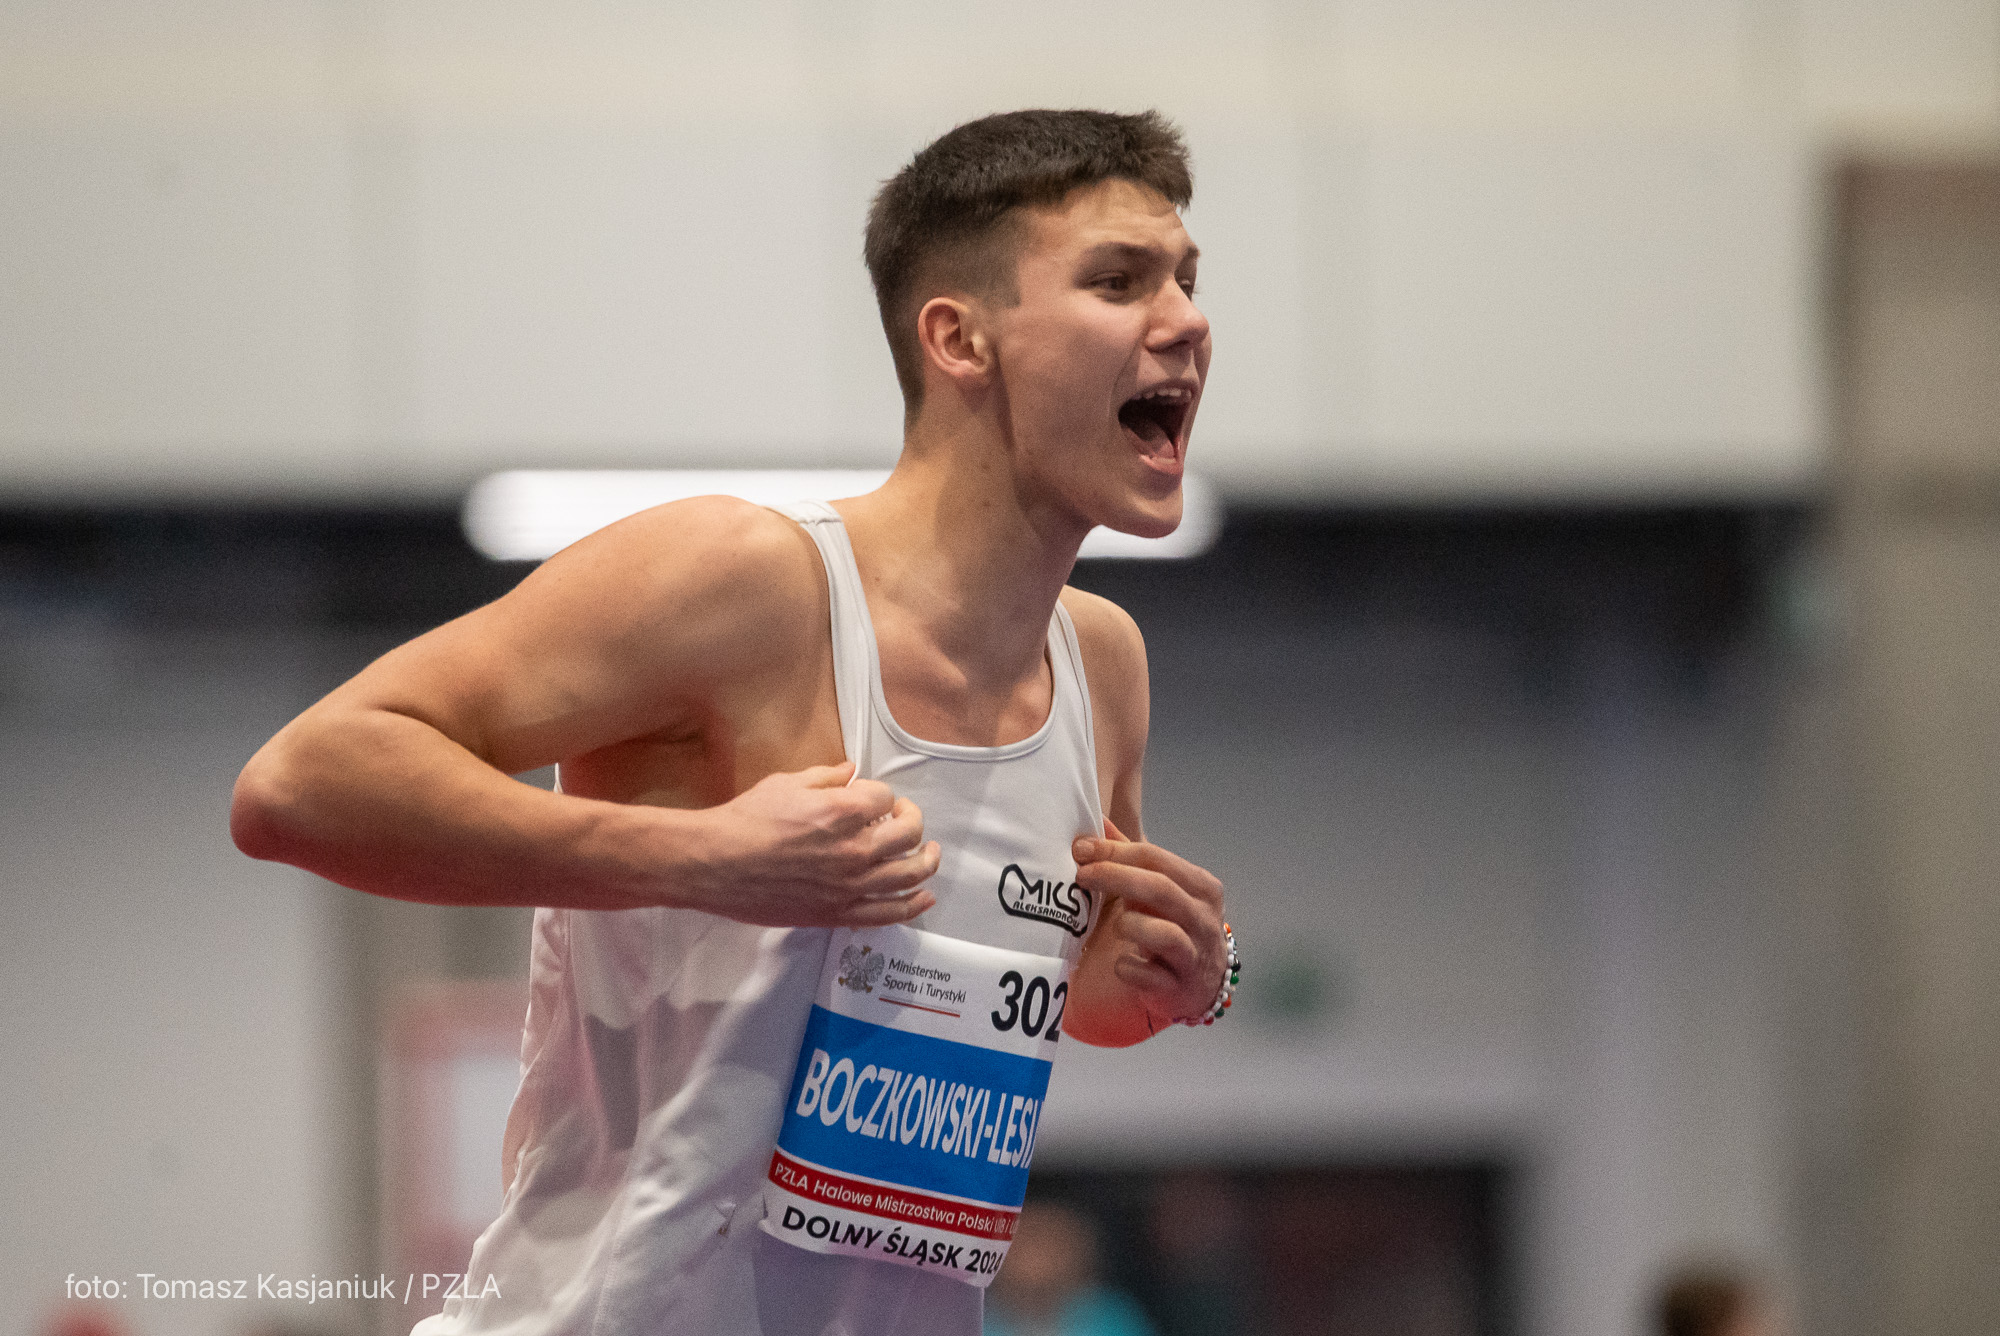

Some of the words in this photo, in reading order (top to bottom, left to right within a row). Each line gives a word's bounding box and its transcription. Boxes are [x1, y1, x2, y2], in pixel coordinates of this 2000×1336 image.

[1012, 900, 1081, 929] ALEKSANDRÓW
[883, 973, 918, 993] Sportu
[919, 982, 925, 994] i
[926, 983, 967, 1004] Turystyki
[888, 957, 951, 983] Ministerstwo
[991, 970, 1068, 1043] 302
[796, 1048, 1042, 1169] BOCZKOWSKI-LESI
[775, 1162, 808, 1191] PZLA
[813, 1179, 873, 1207] Halowe
[875, 1194, 956, 1225] Mistrzostwa
[957, 1211, 995, 1232] Polski
[782, 1205, 883, 1248] DOLNY
[882, 1226, 964, 1269] ŚLĄSK
